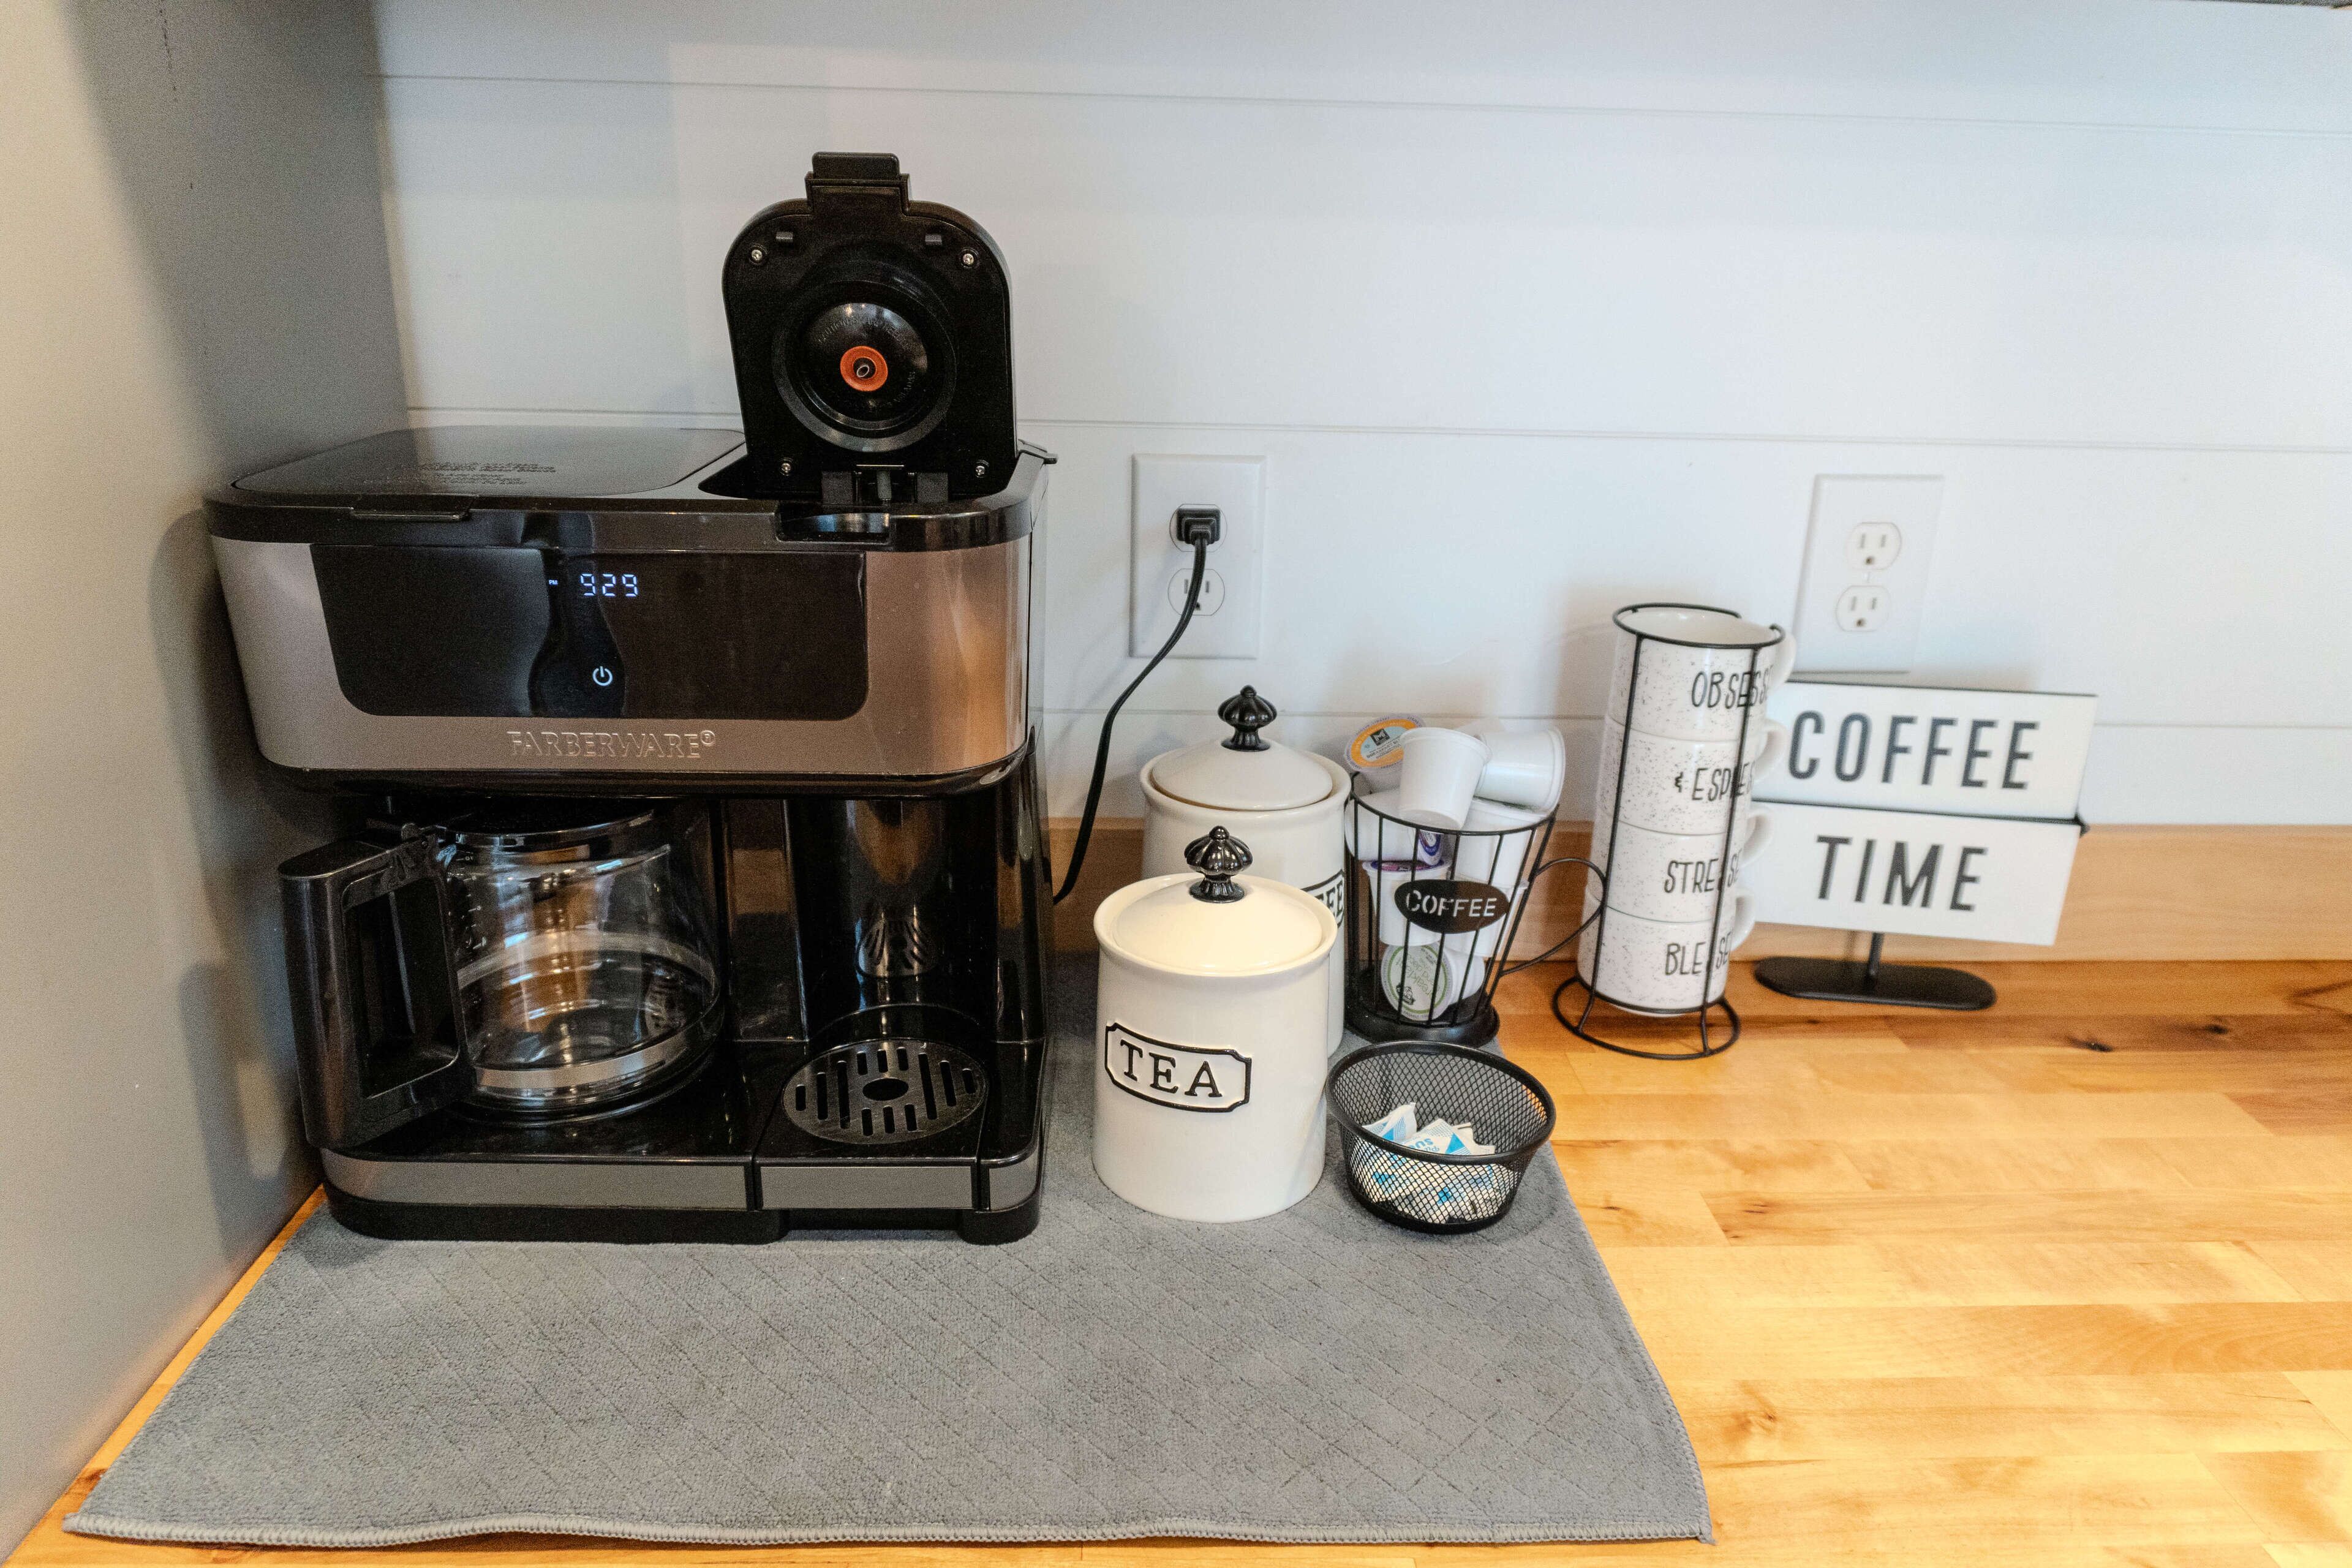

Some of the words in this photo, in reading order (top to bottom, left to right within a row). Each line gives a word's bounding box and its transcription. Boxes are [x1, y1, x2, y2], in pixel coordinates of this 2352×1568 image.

[580, 573, 638, 597] 929
[1788, 710, 2040, 790] COFFEE
[1816, 835, 1988, 912] TIME
[1406, 890, 1497, 917] COFFEE
[1120, 1039, 1223, 1097] TEA
